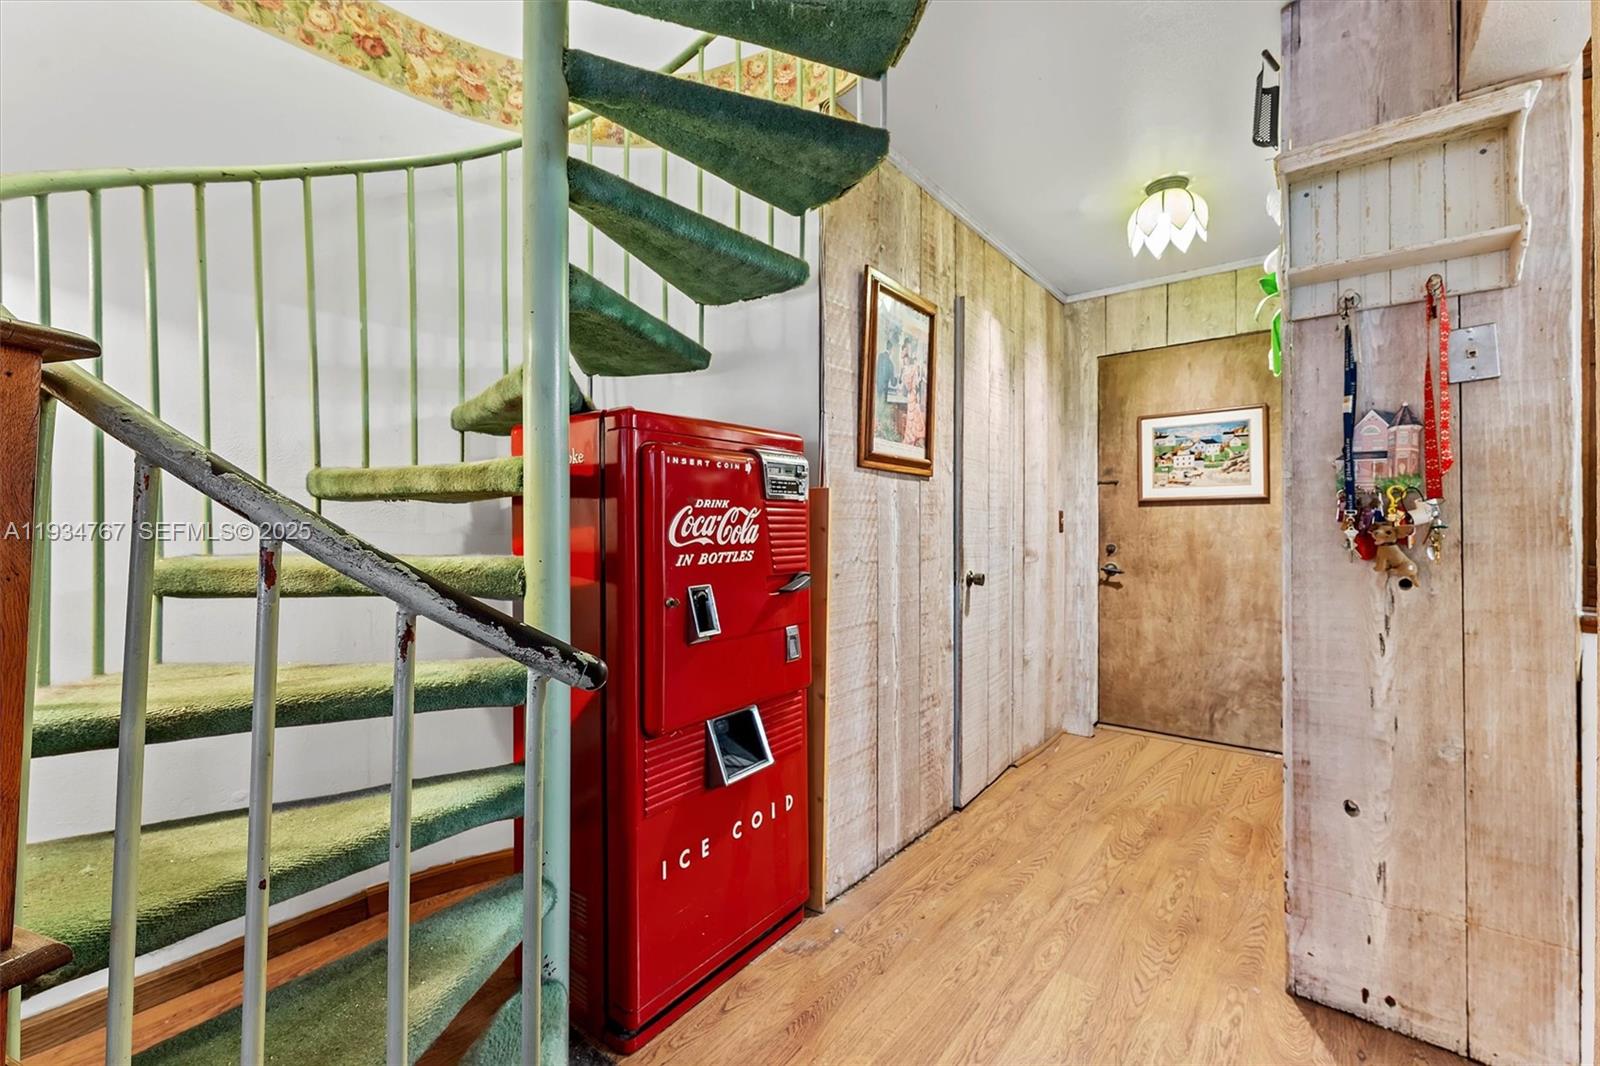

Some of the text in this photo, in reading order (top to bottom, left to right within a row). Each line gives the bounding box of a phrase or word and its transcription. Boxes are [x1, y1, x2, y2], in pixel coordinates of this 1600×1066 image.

[666, 456, 740, 470] INSERT COIN
[694, 499, 730, 508] DRINK
[668, 505, 762, 548] Coca-Cola
[675, 550, 755, 567] IN BOTTLES
[662, 837, 710, 880] ICE
